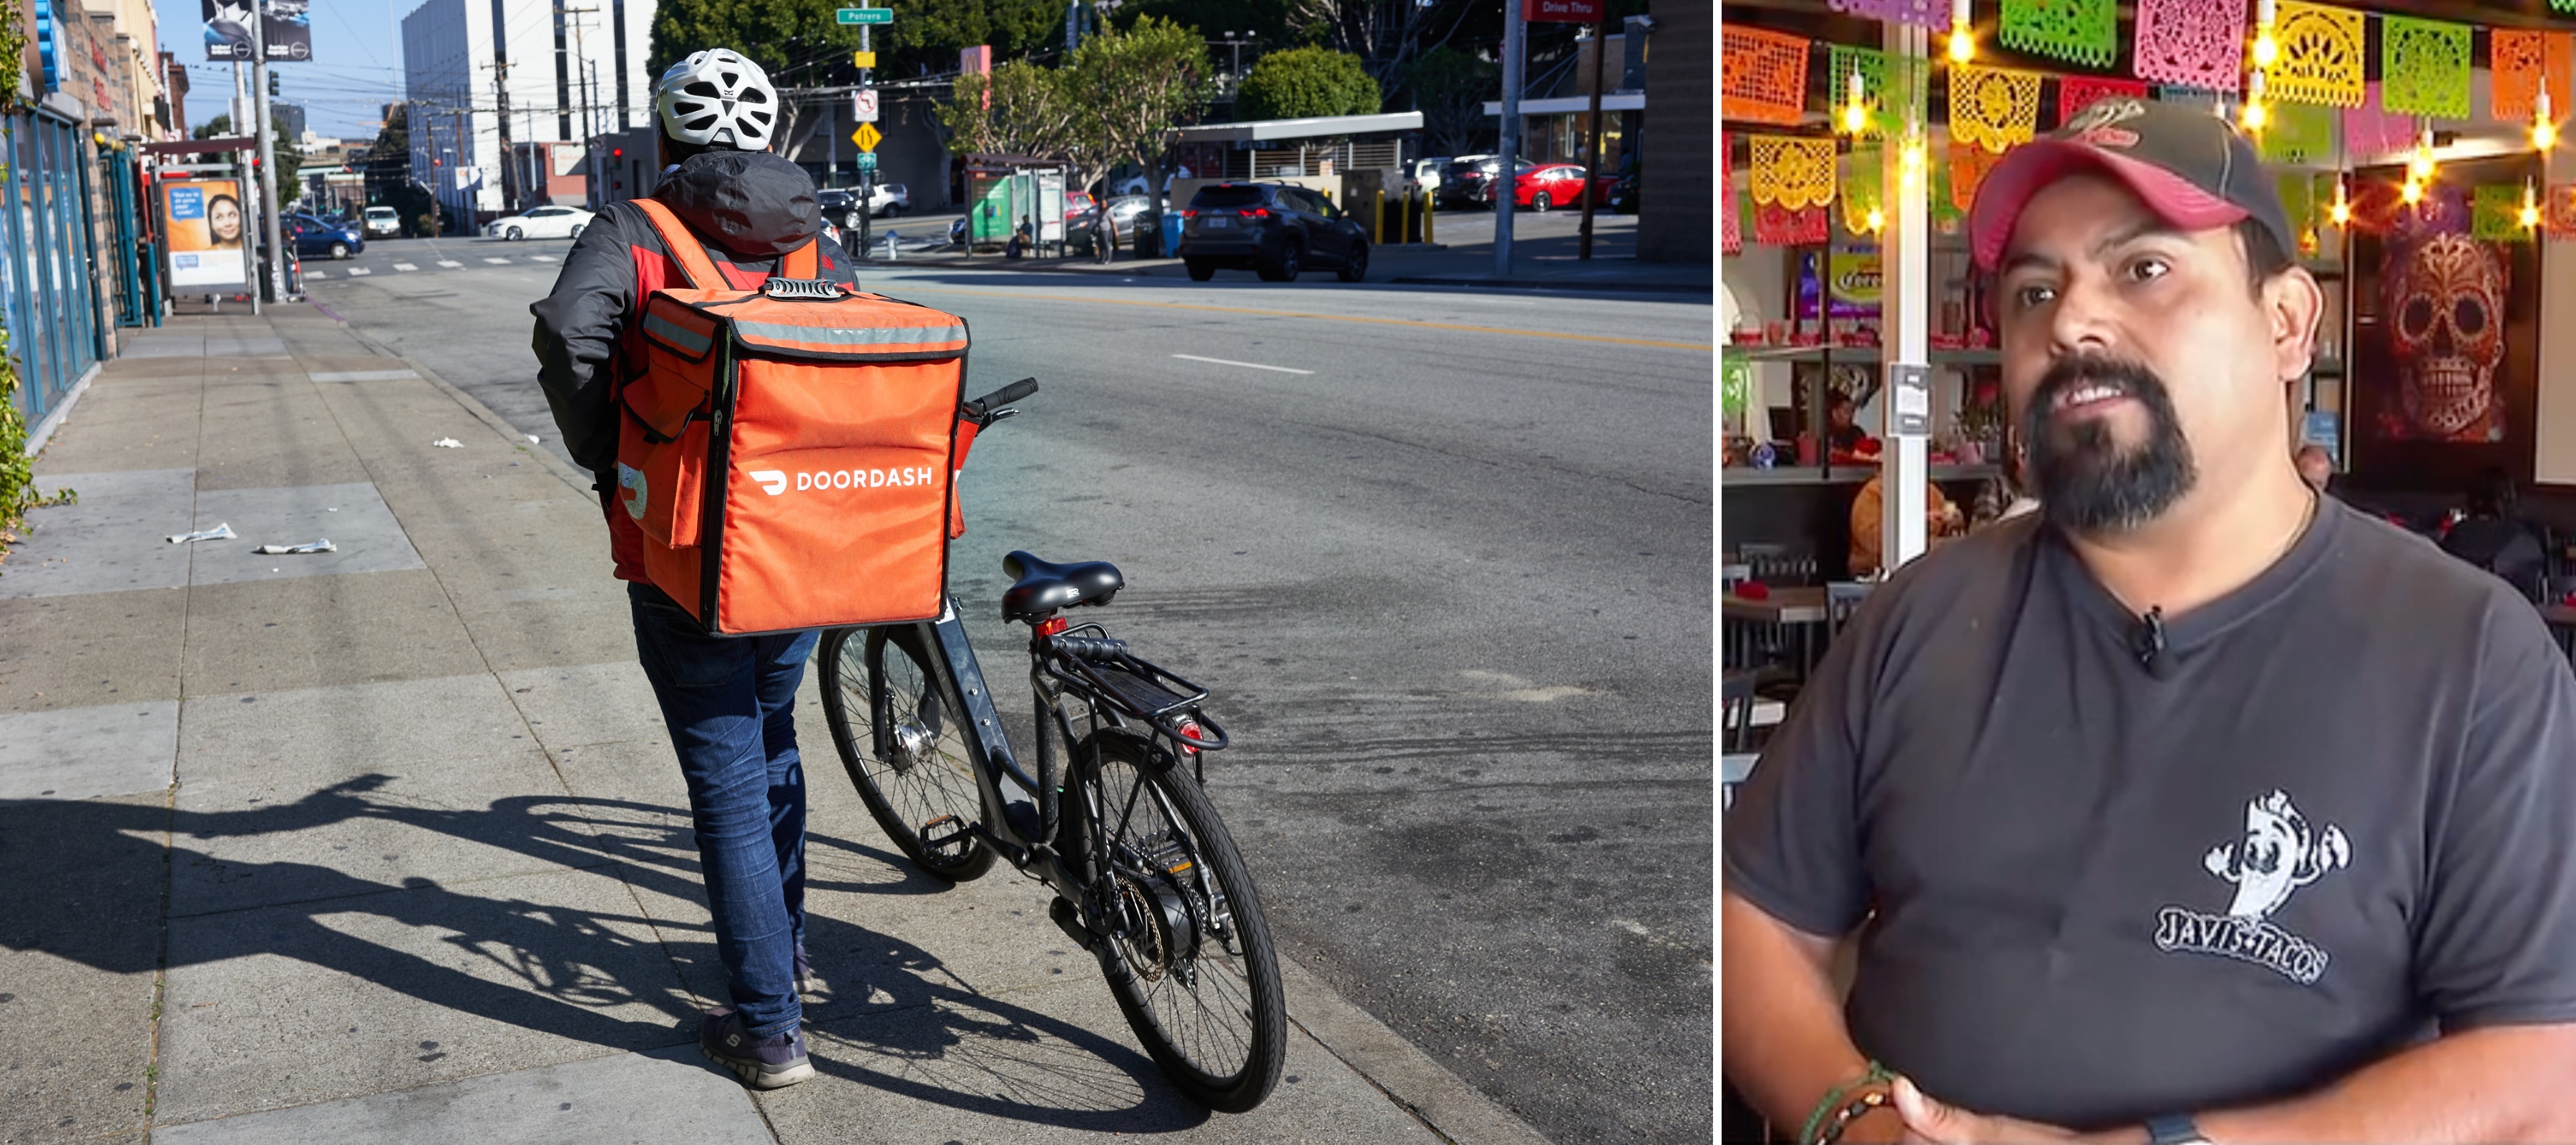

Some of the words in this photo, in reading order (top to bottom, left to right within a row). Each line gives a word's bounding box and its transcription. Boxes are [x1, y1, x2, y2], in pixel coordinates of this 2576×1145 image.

[1543, 1, 1568, 12] Drive
[1571, 3, 1592, 14] Thru
[796, 467, 932, 492] DOORDASH
[947, 691, 974, 754] BIKES
[2254, 930, 2328, 985] TACOS
